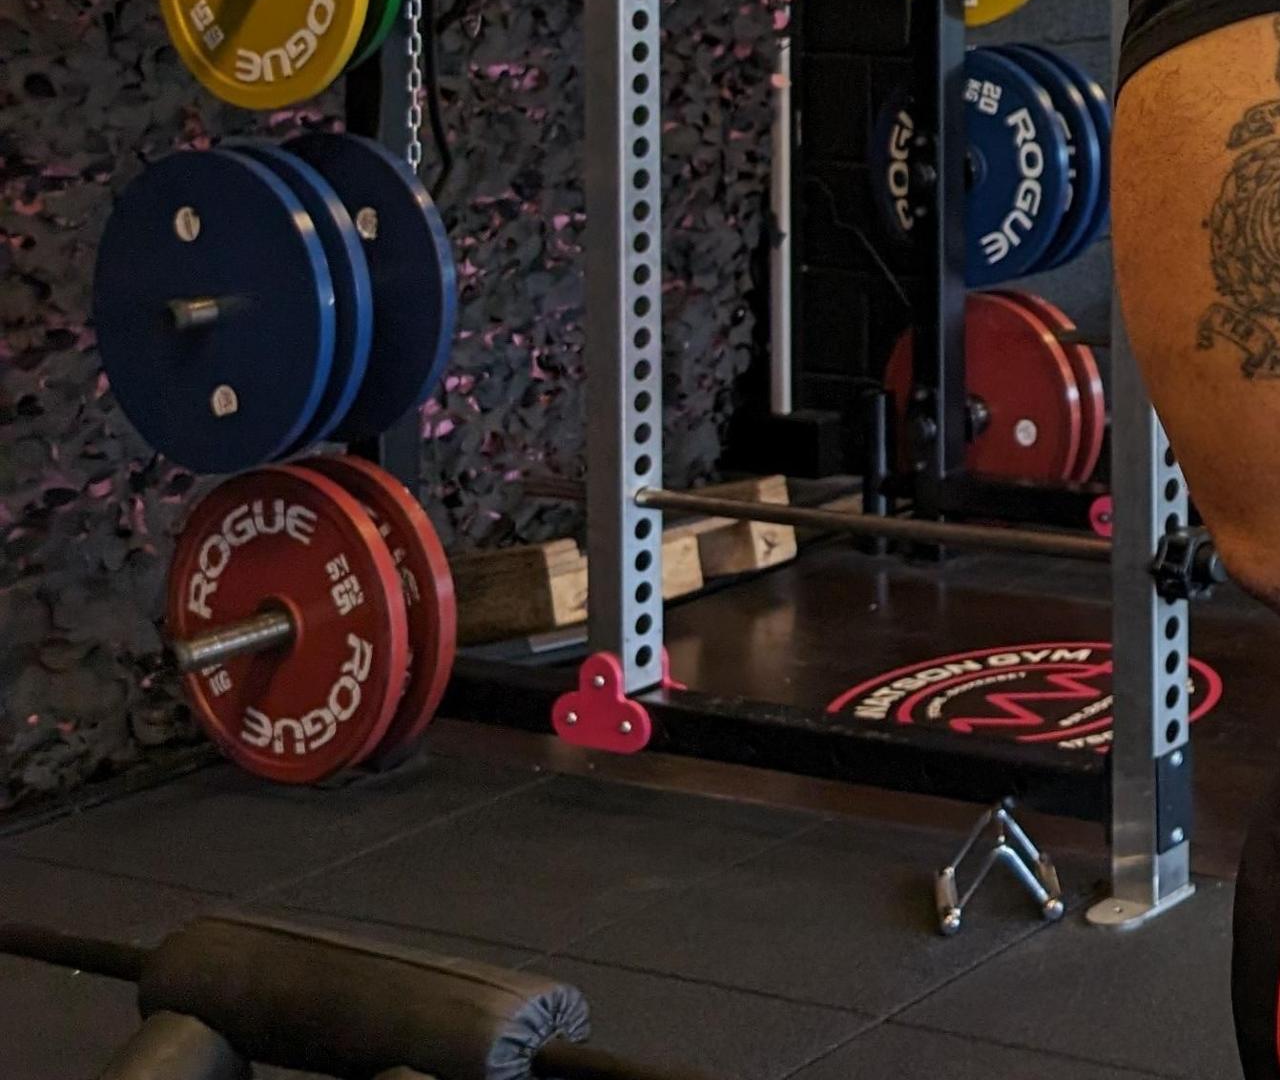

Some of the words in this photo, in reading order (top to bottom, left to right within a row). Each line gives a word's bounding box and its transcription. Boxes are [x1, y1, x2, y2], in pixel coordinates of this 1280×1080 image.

[979, 80, 1002, 115] 20
[979, 107, 1045, 265] ROGUE
[187, 499, 318, 619] ROGUE
[241, 632, 374, 754] ROGUE
[986, 649, 1093, 667] GYM
